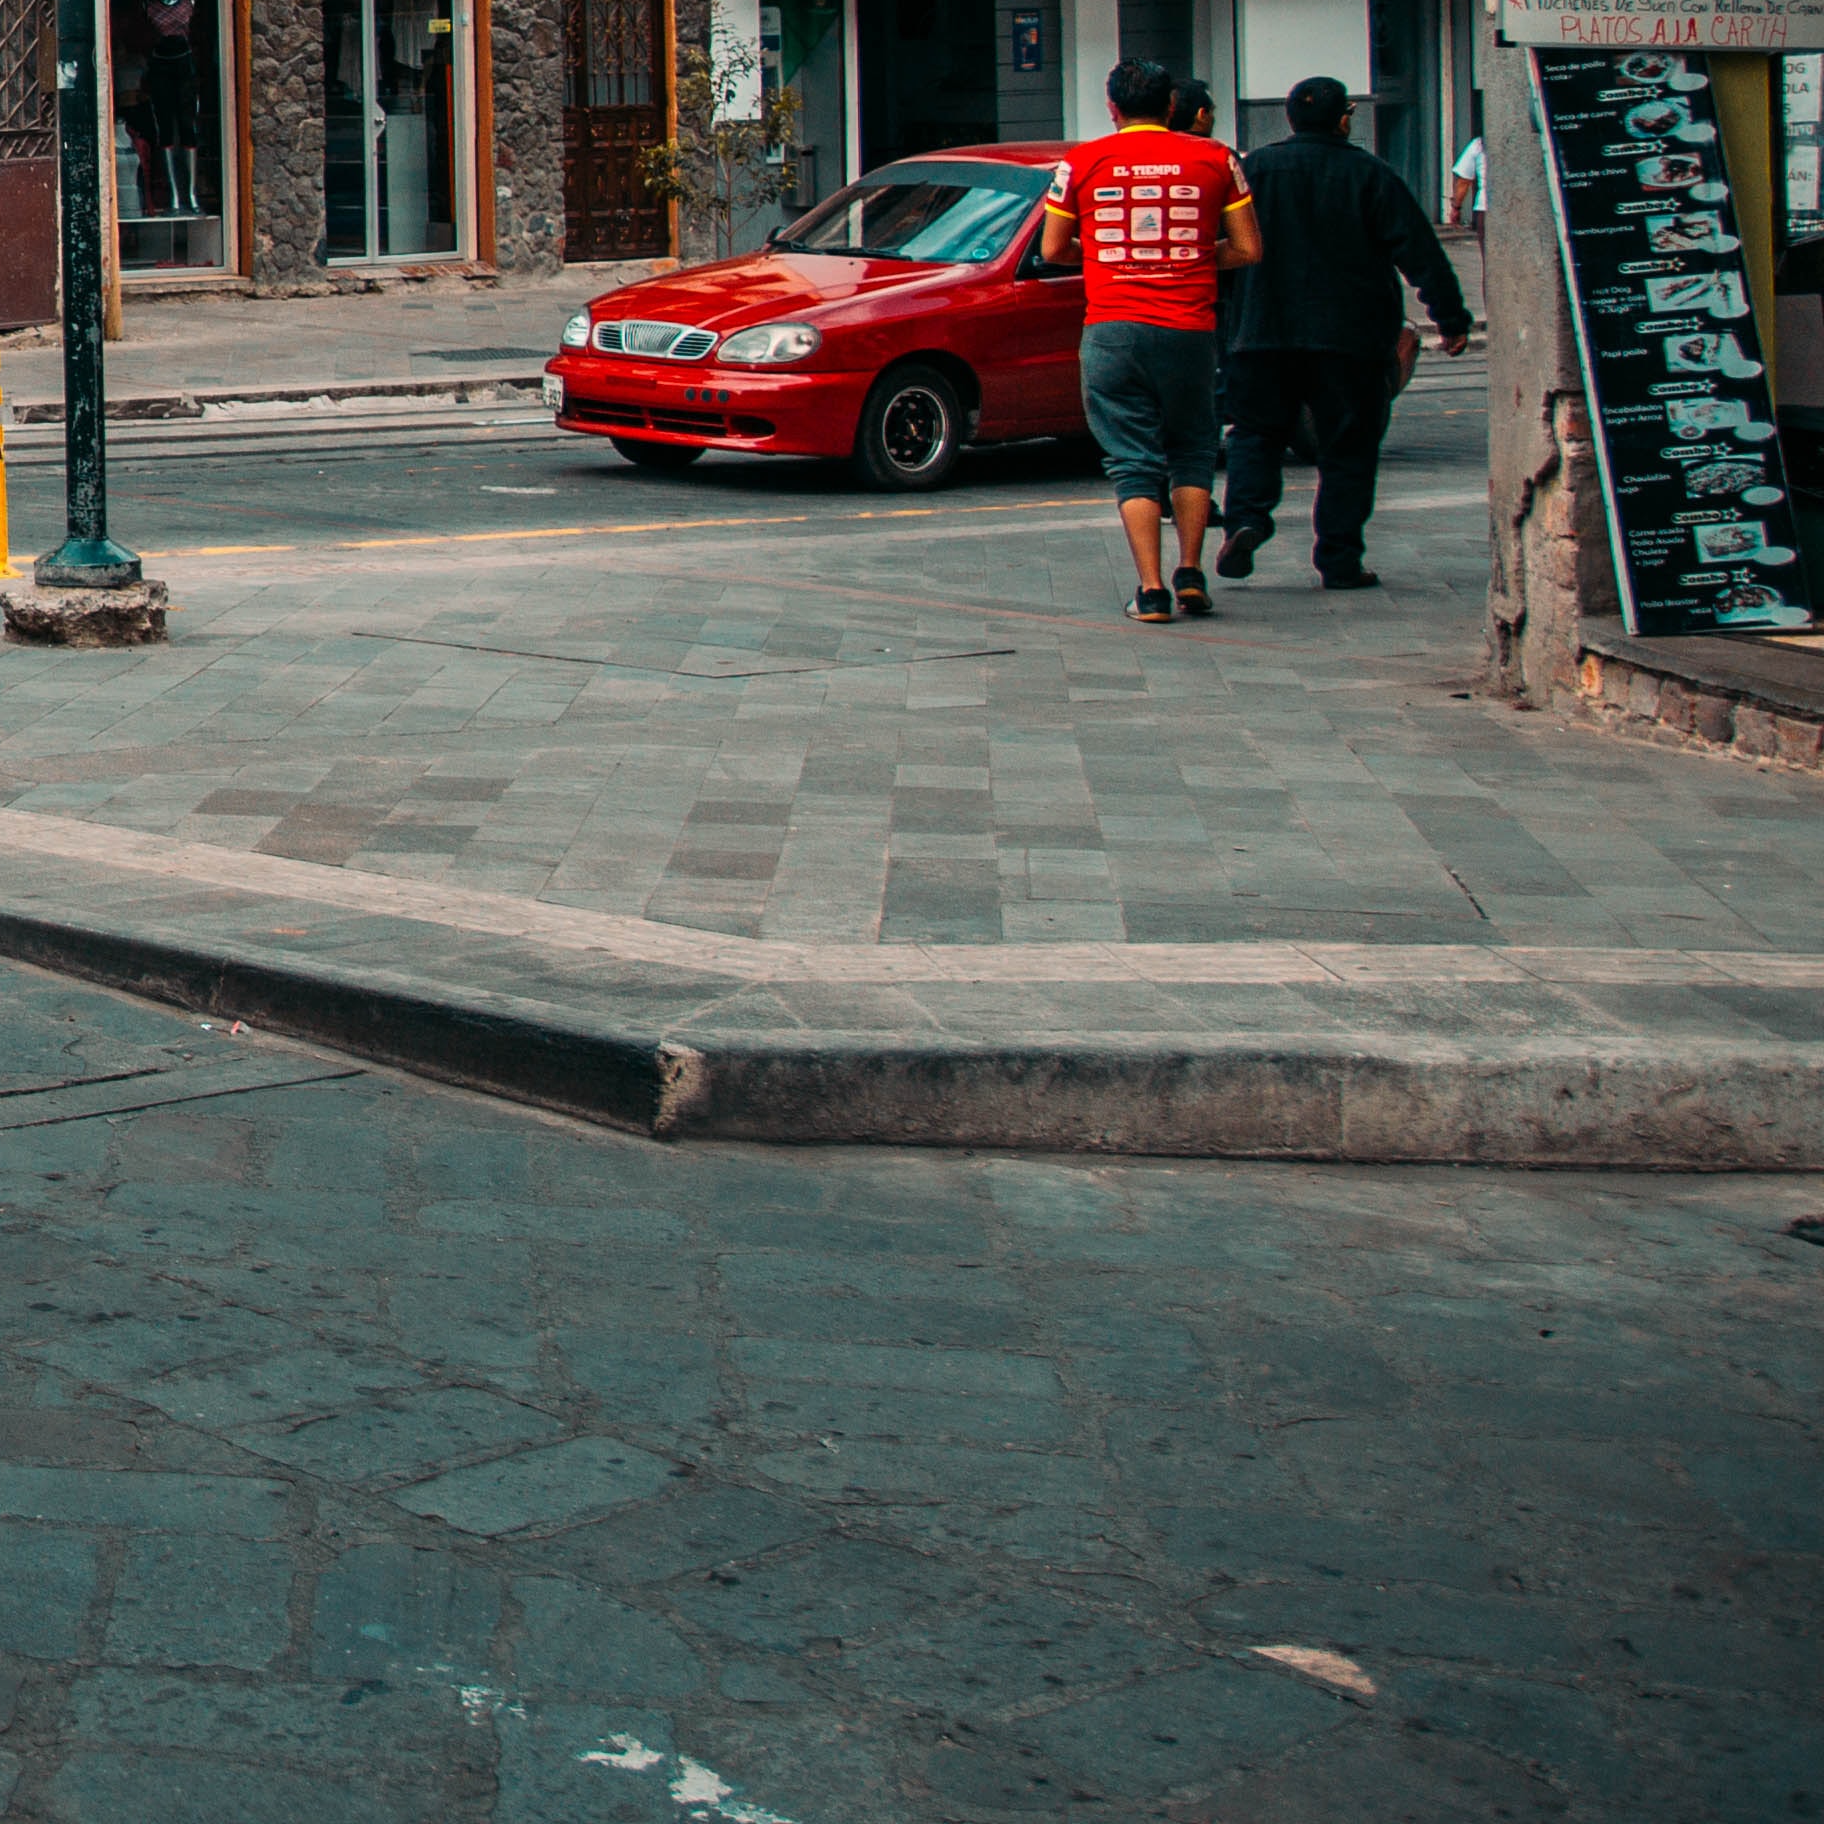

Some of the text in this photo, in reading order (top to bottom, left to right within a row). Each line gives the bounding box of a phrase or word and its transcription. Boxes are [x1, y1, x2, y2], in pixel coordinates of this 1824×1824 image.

[1561, 16, 1643, 44] PLATOS
[1131, 164, 1181, 176] TIEMPO
[1661, 445, 1713, 459] Combo
[1672, 510, 1721, 524] Combo
